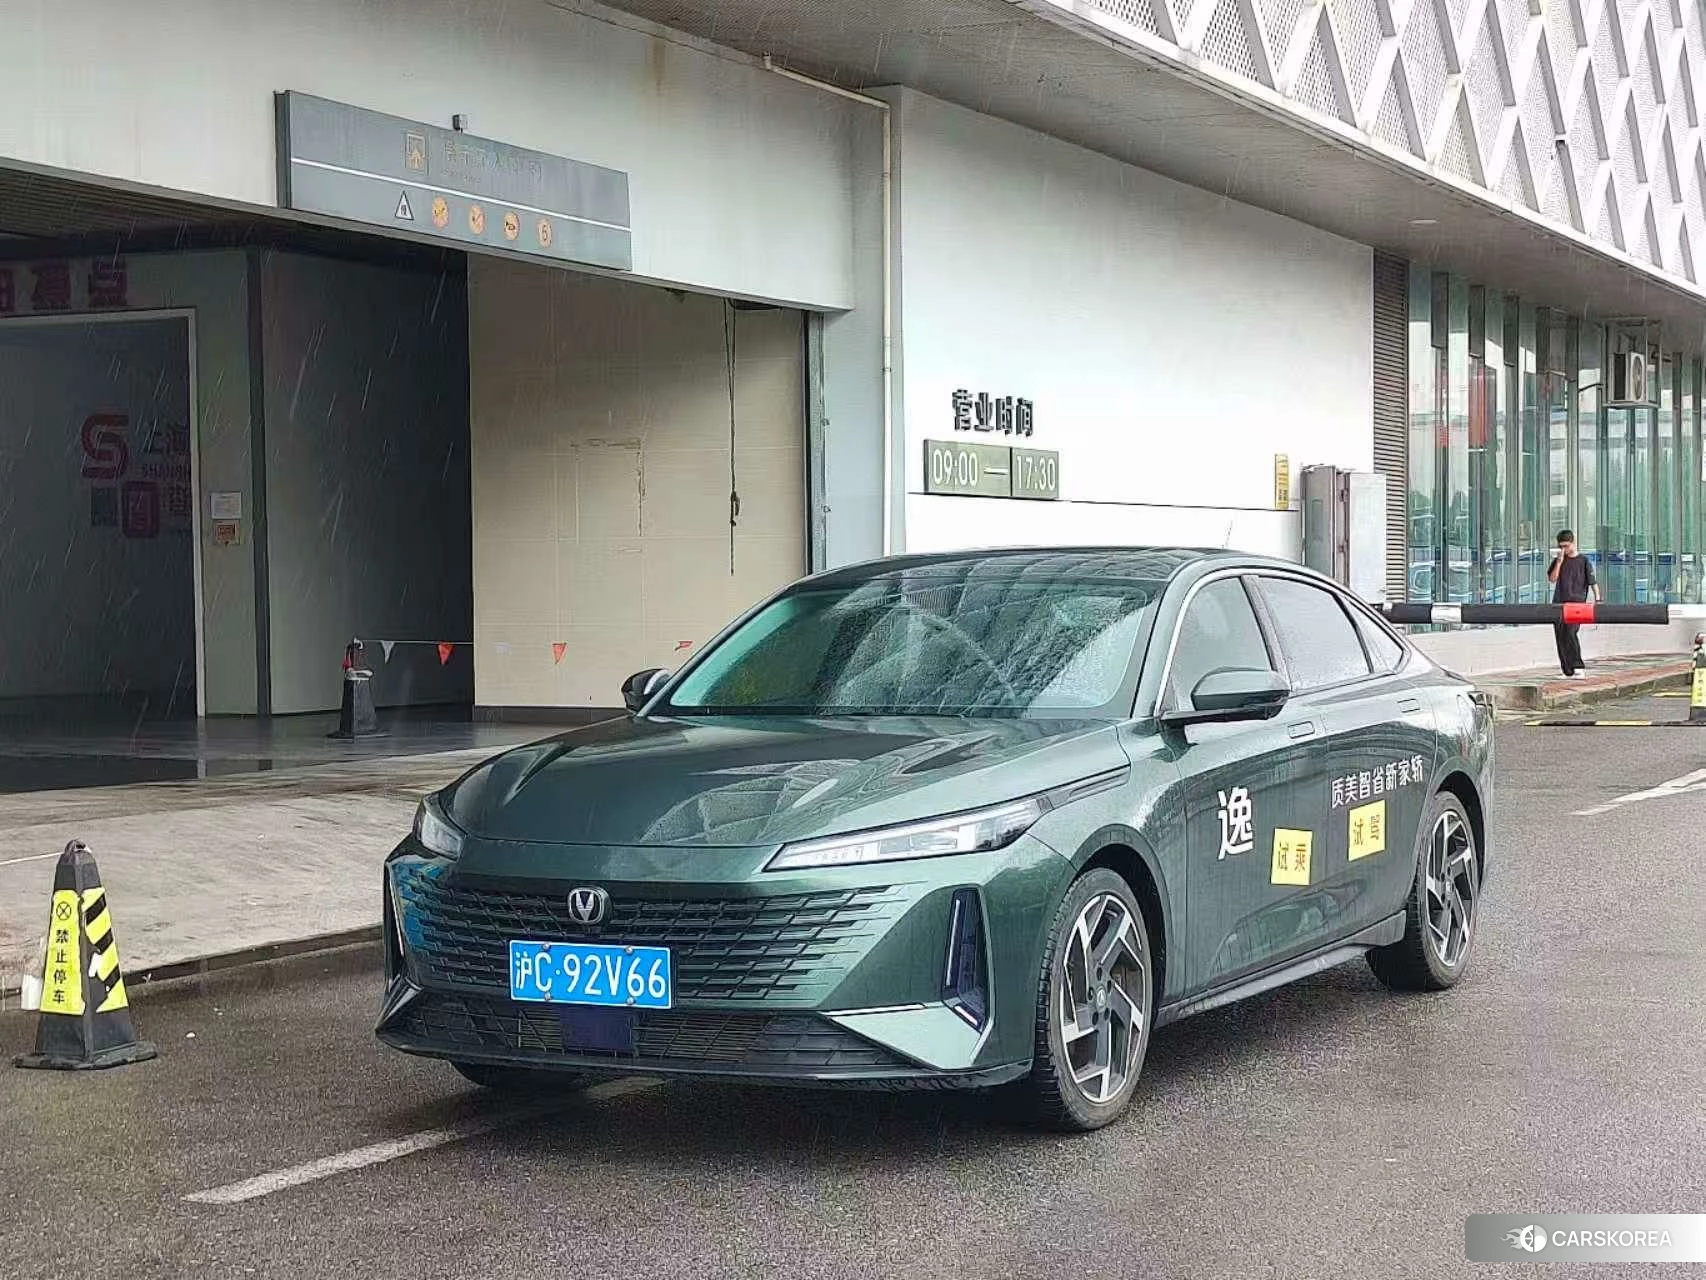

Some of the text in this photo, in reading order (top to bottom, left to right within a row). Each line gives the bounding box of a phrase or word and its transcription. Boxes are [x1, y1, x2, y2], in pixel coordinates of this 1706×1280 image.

[952, 389, 1033, 437] 营业时间
[933, 448, 978, 486] 09:00
[1017, 455, 1056, 491] 17:30
[1331, 755, 1424, 809] 质美智省新家轿
[1217, 786, 1254, 860] 逸
[52, 929, 70, 1004] 禁止停车
[515, 951, 666, 998] 沪C·92V66
